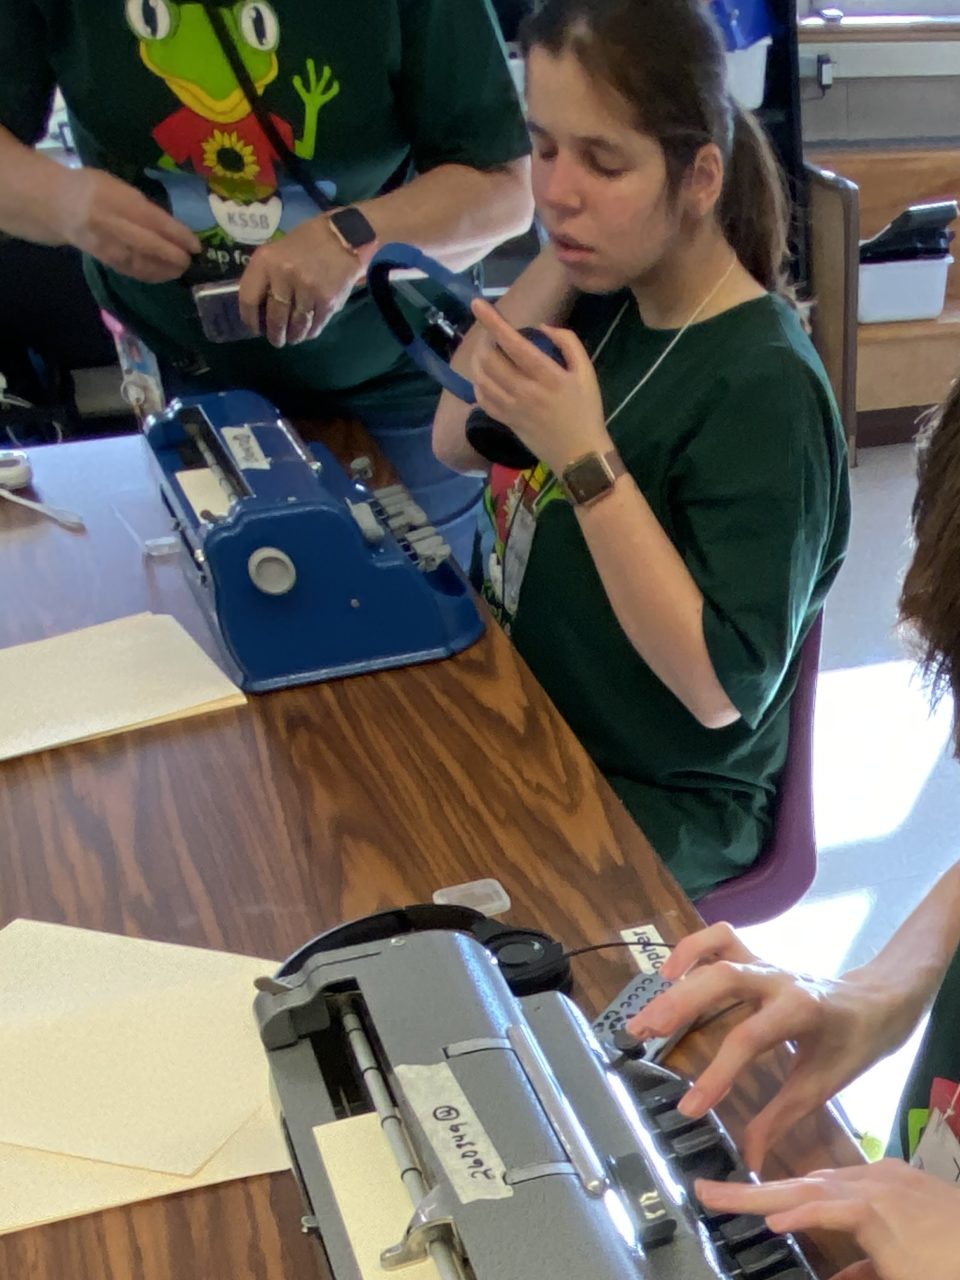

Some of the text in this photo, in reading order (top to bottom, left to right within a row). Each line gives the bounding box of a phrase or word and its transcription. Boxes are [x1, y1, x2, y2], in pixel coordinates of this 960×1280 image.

[227, 212, 270, 231] KSSB
[206, 247, 231, 273] ap
[632, 930, 667, 972] opher
